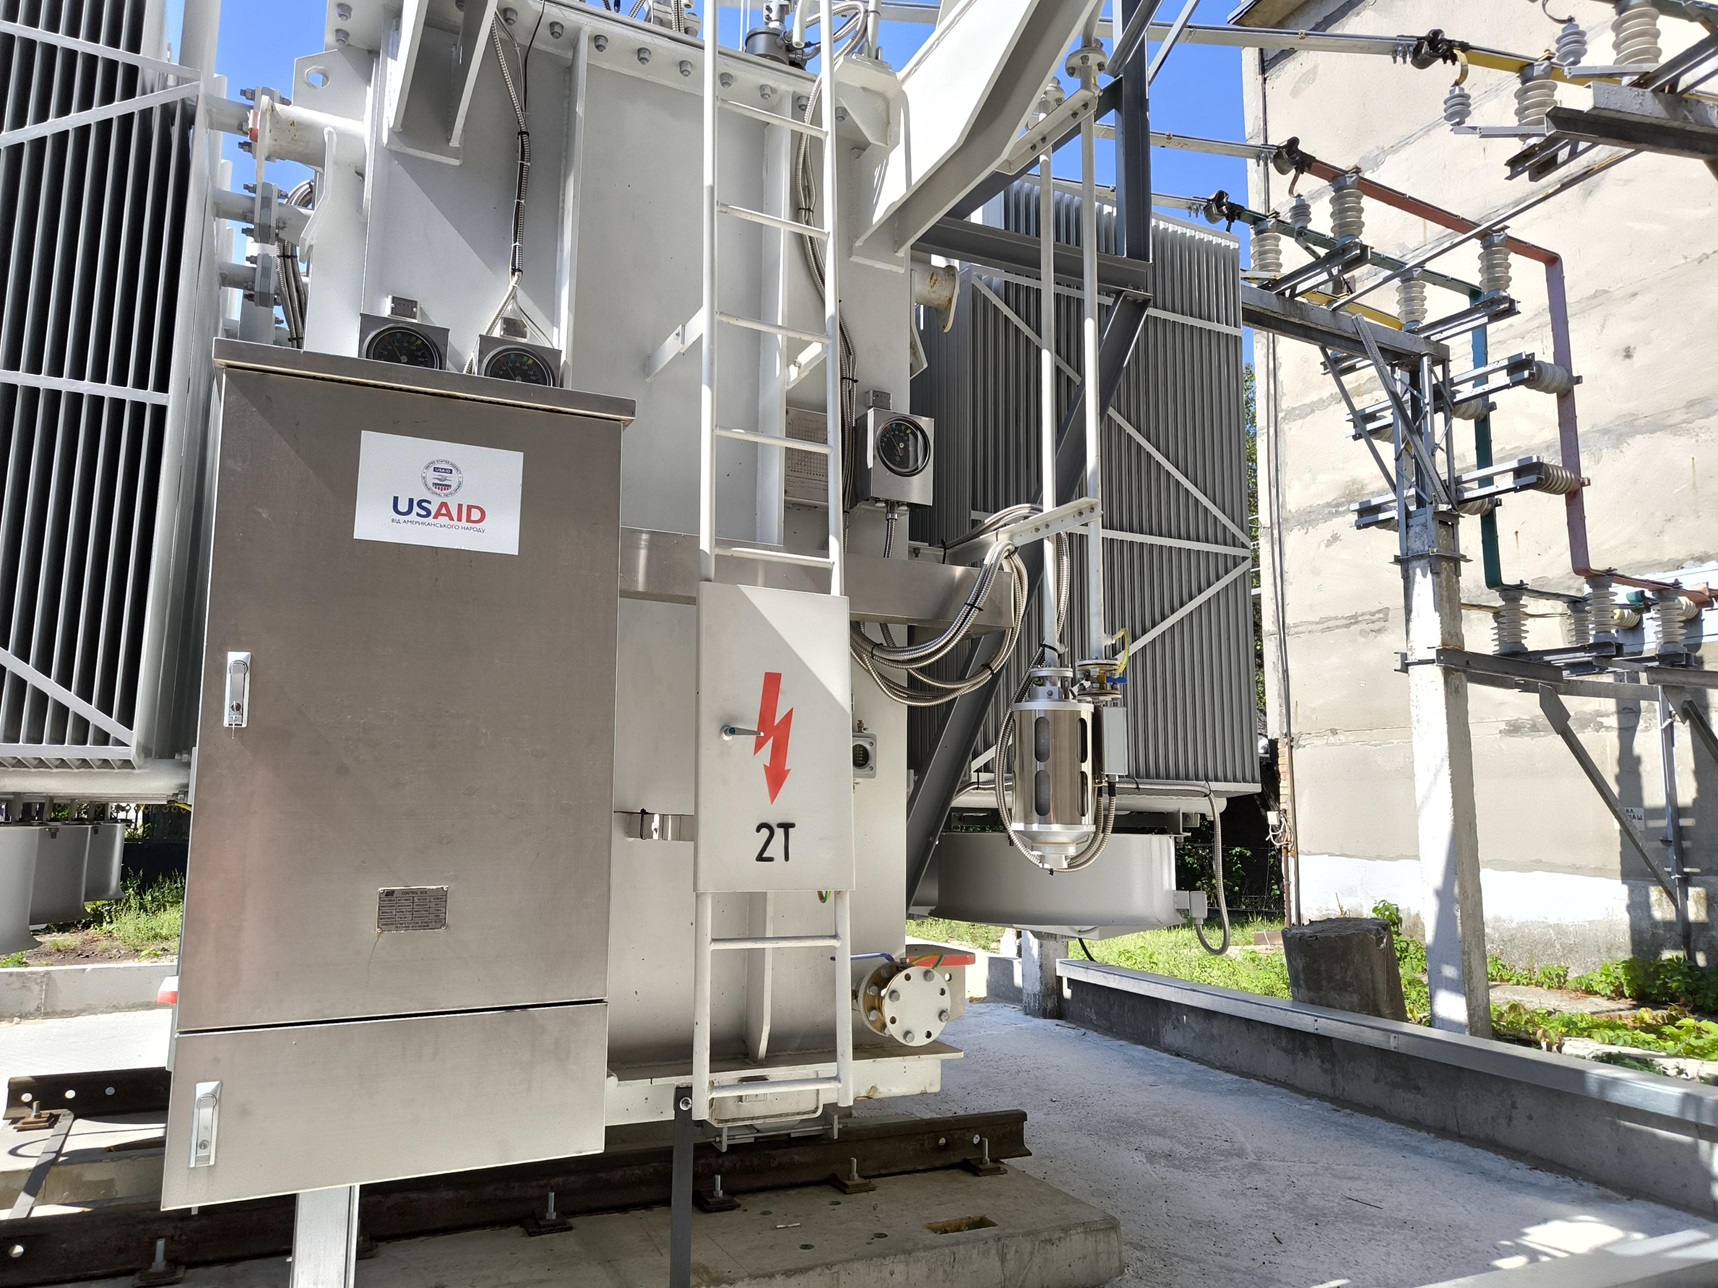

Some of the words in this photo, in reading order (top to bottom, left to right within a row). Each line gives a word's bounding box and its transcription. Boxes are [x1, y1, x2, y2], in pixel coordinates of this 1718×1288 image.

[393, 496, 486, 524] USAID
[402, 519, 460, 530] АМЕРИКАНСЬКОГО
[461, 526, 486, 534] НАРОДУ
